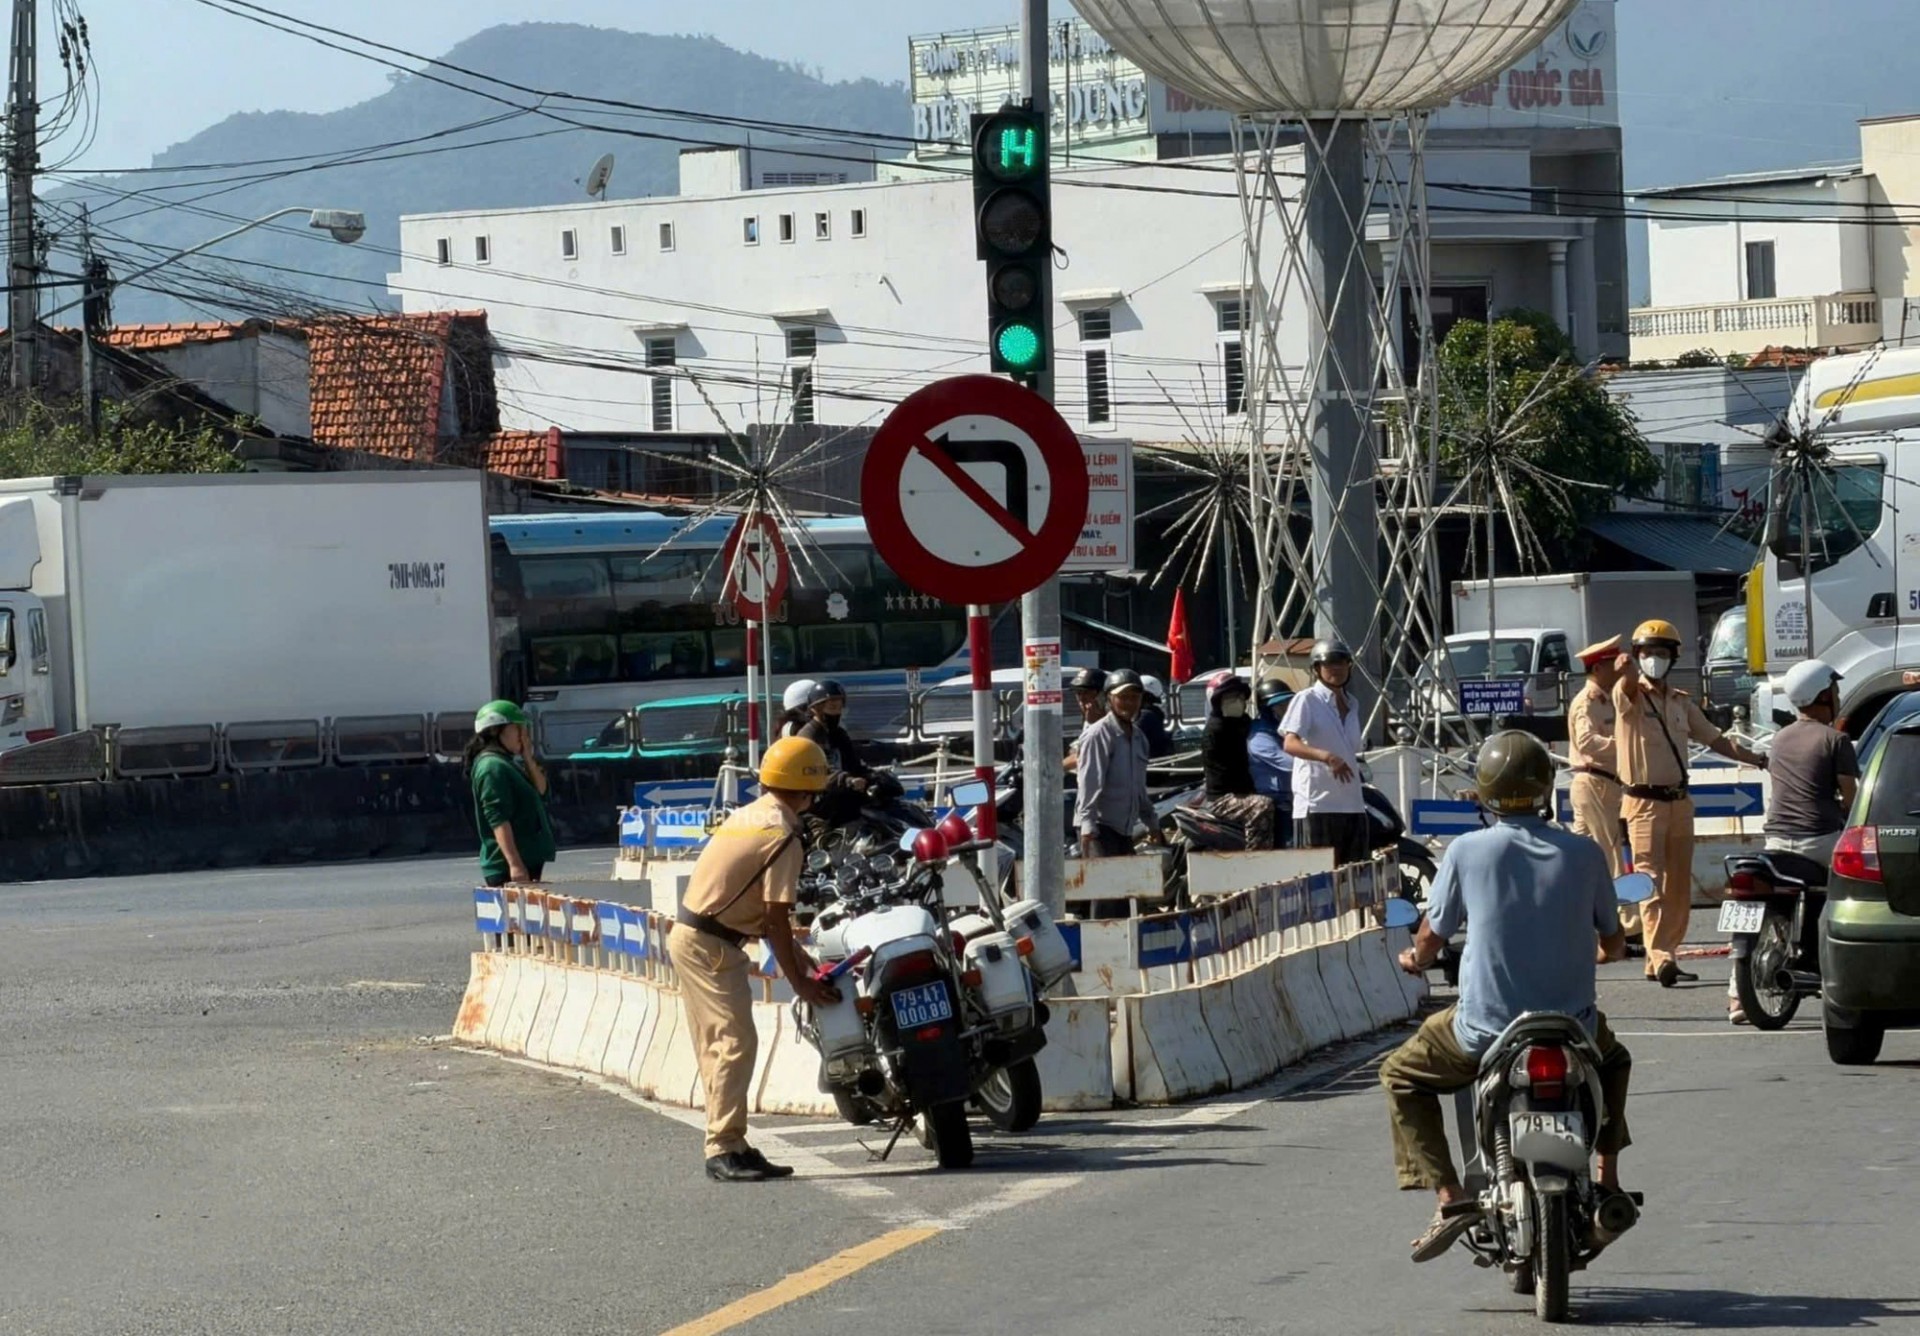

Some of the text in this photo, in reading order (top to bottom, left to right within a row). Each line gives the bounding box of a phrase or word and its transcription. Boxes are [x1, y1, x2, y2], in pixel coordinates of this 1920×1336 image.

[1508, 58, 1562, 110] QUỐC
[1568, 69, 1604, 106] GIA
[1001, 129, 1034, 168] 14
[1093, 452, 1118, 468] LỆNH
[1466, 699, 1518, 712] CẤM VÀO!
[899, 1000, 948, 1025] 000.88
